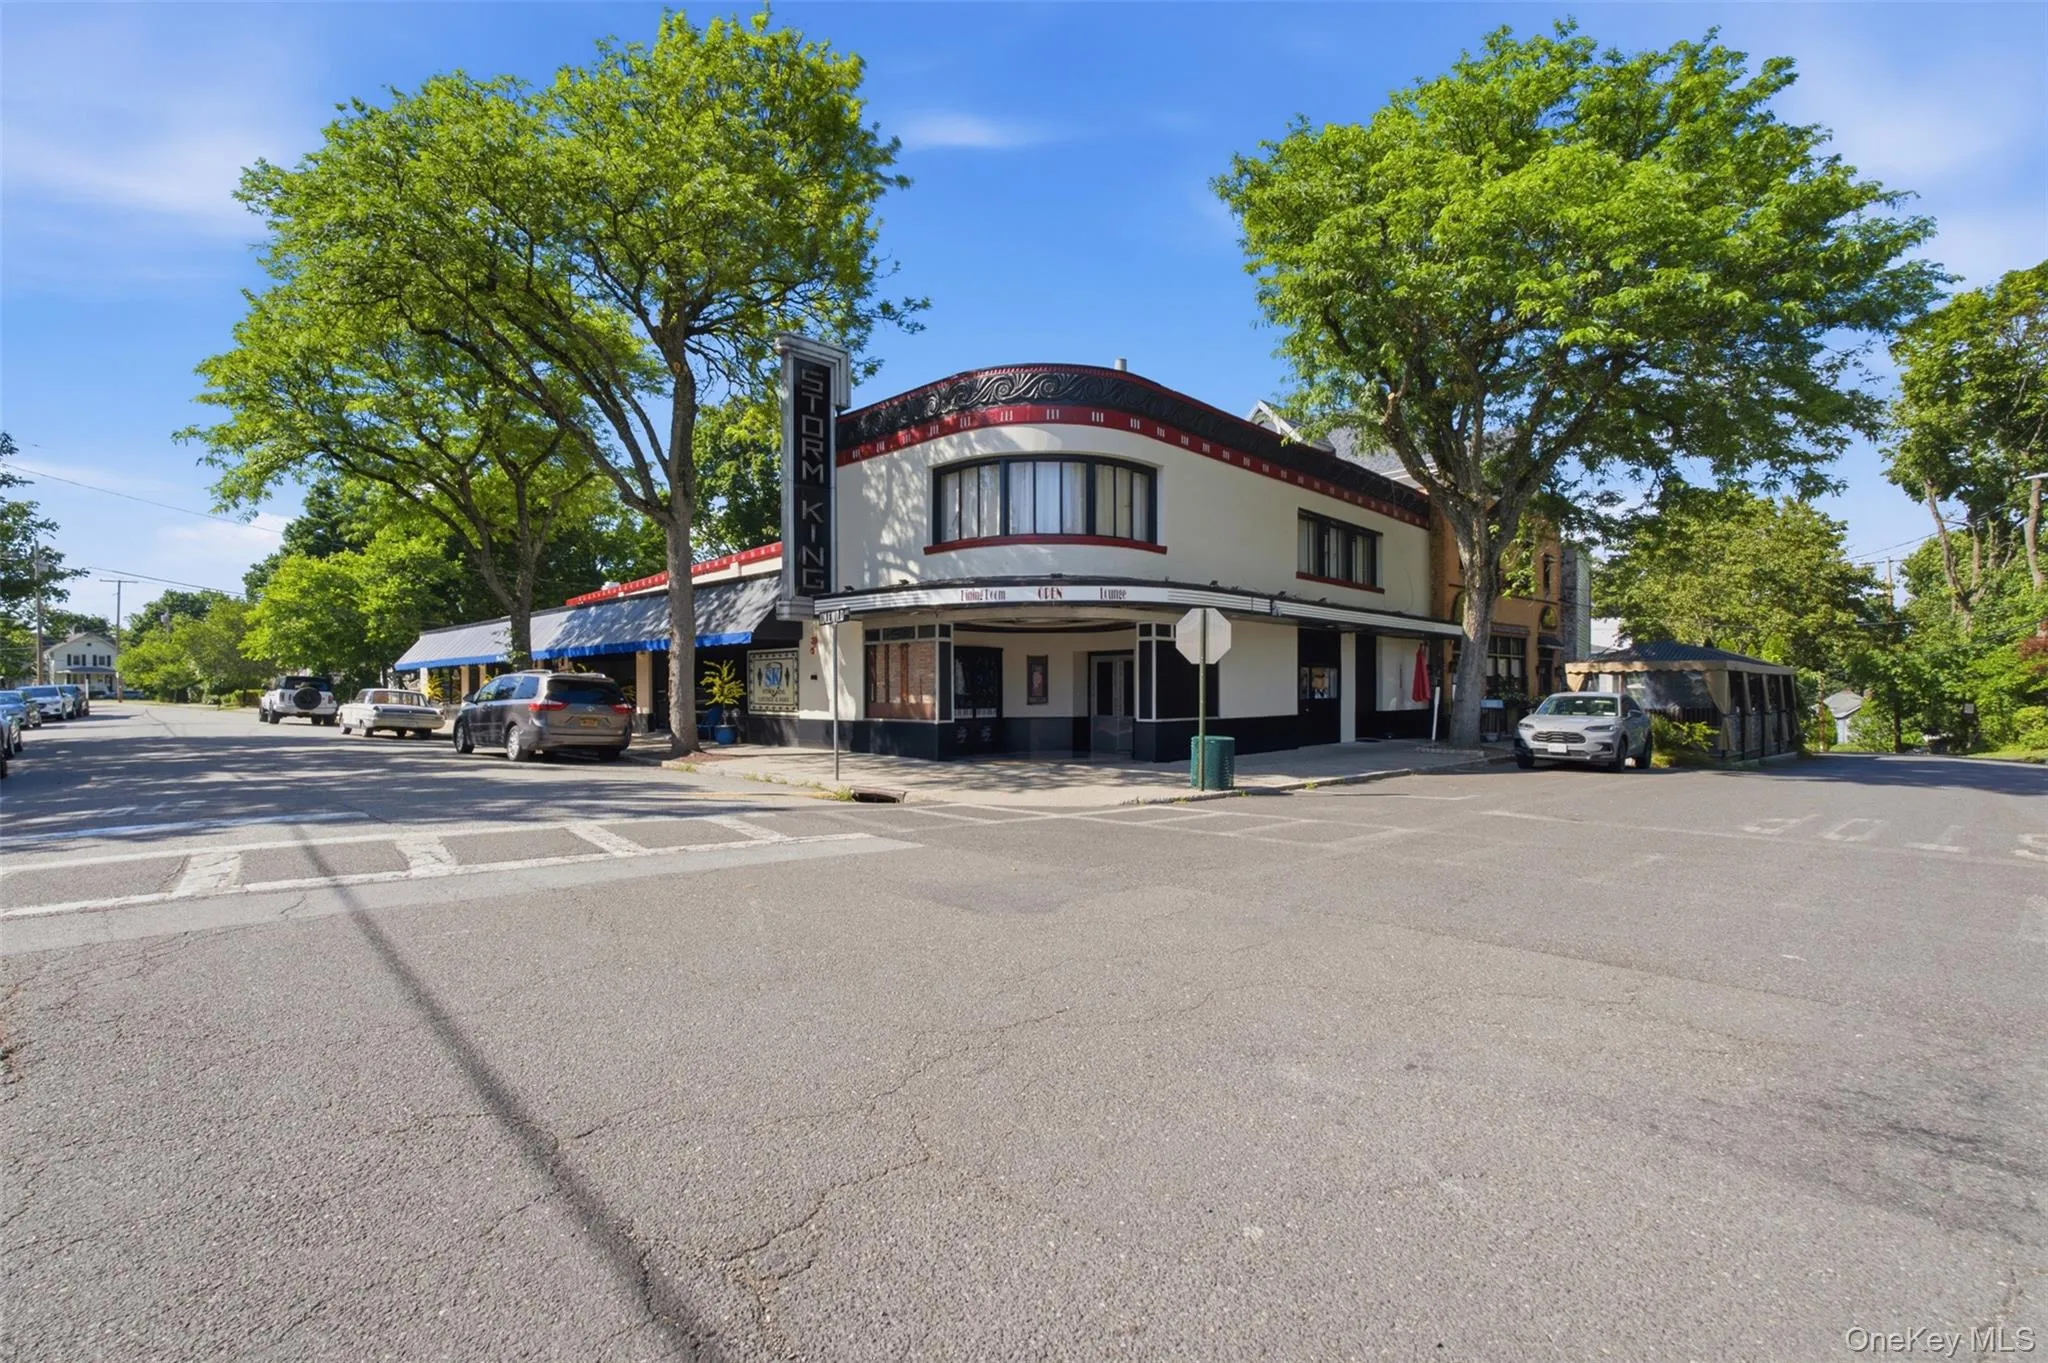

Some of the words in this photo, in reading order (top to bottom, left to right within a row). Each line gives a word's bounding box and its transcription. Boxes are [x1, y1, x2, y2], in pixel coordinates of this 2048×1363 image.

[801, 367, 824, 484] STORM
[802, 499, 824, 590] KING
[1037, 587, 1064, 600] OPEN
[1100, 587, 1127, 600] Lounge
